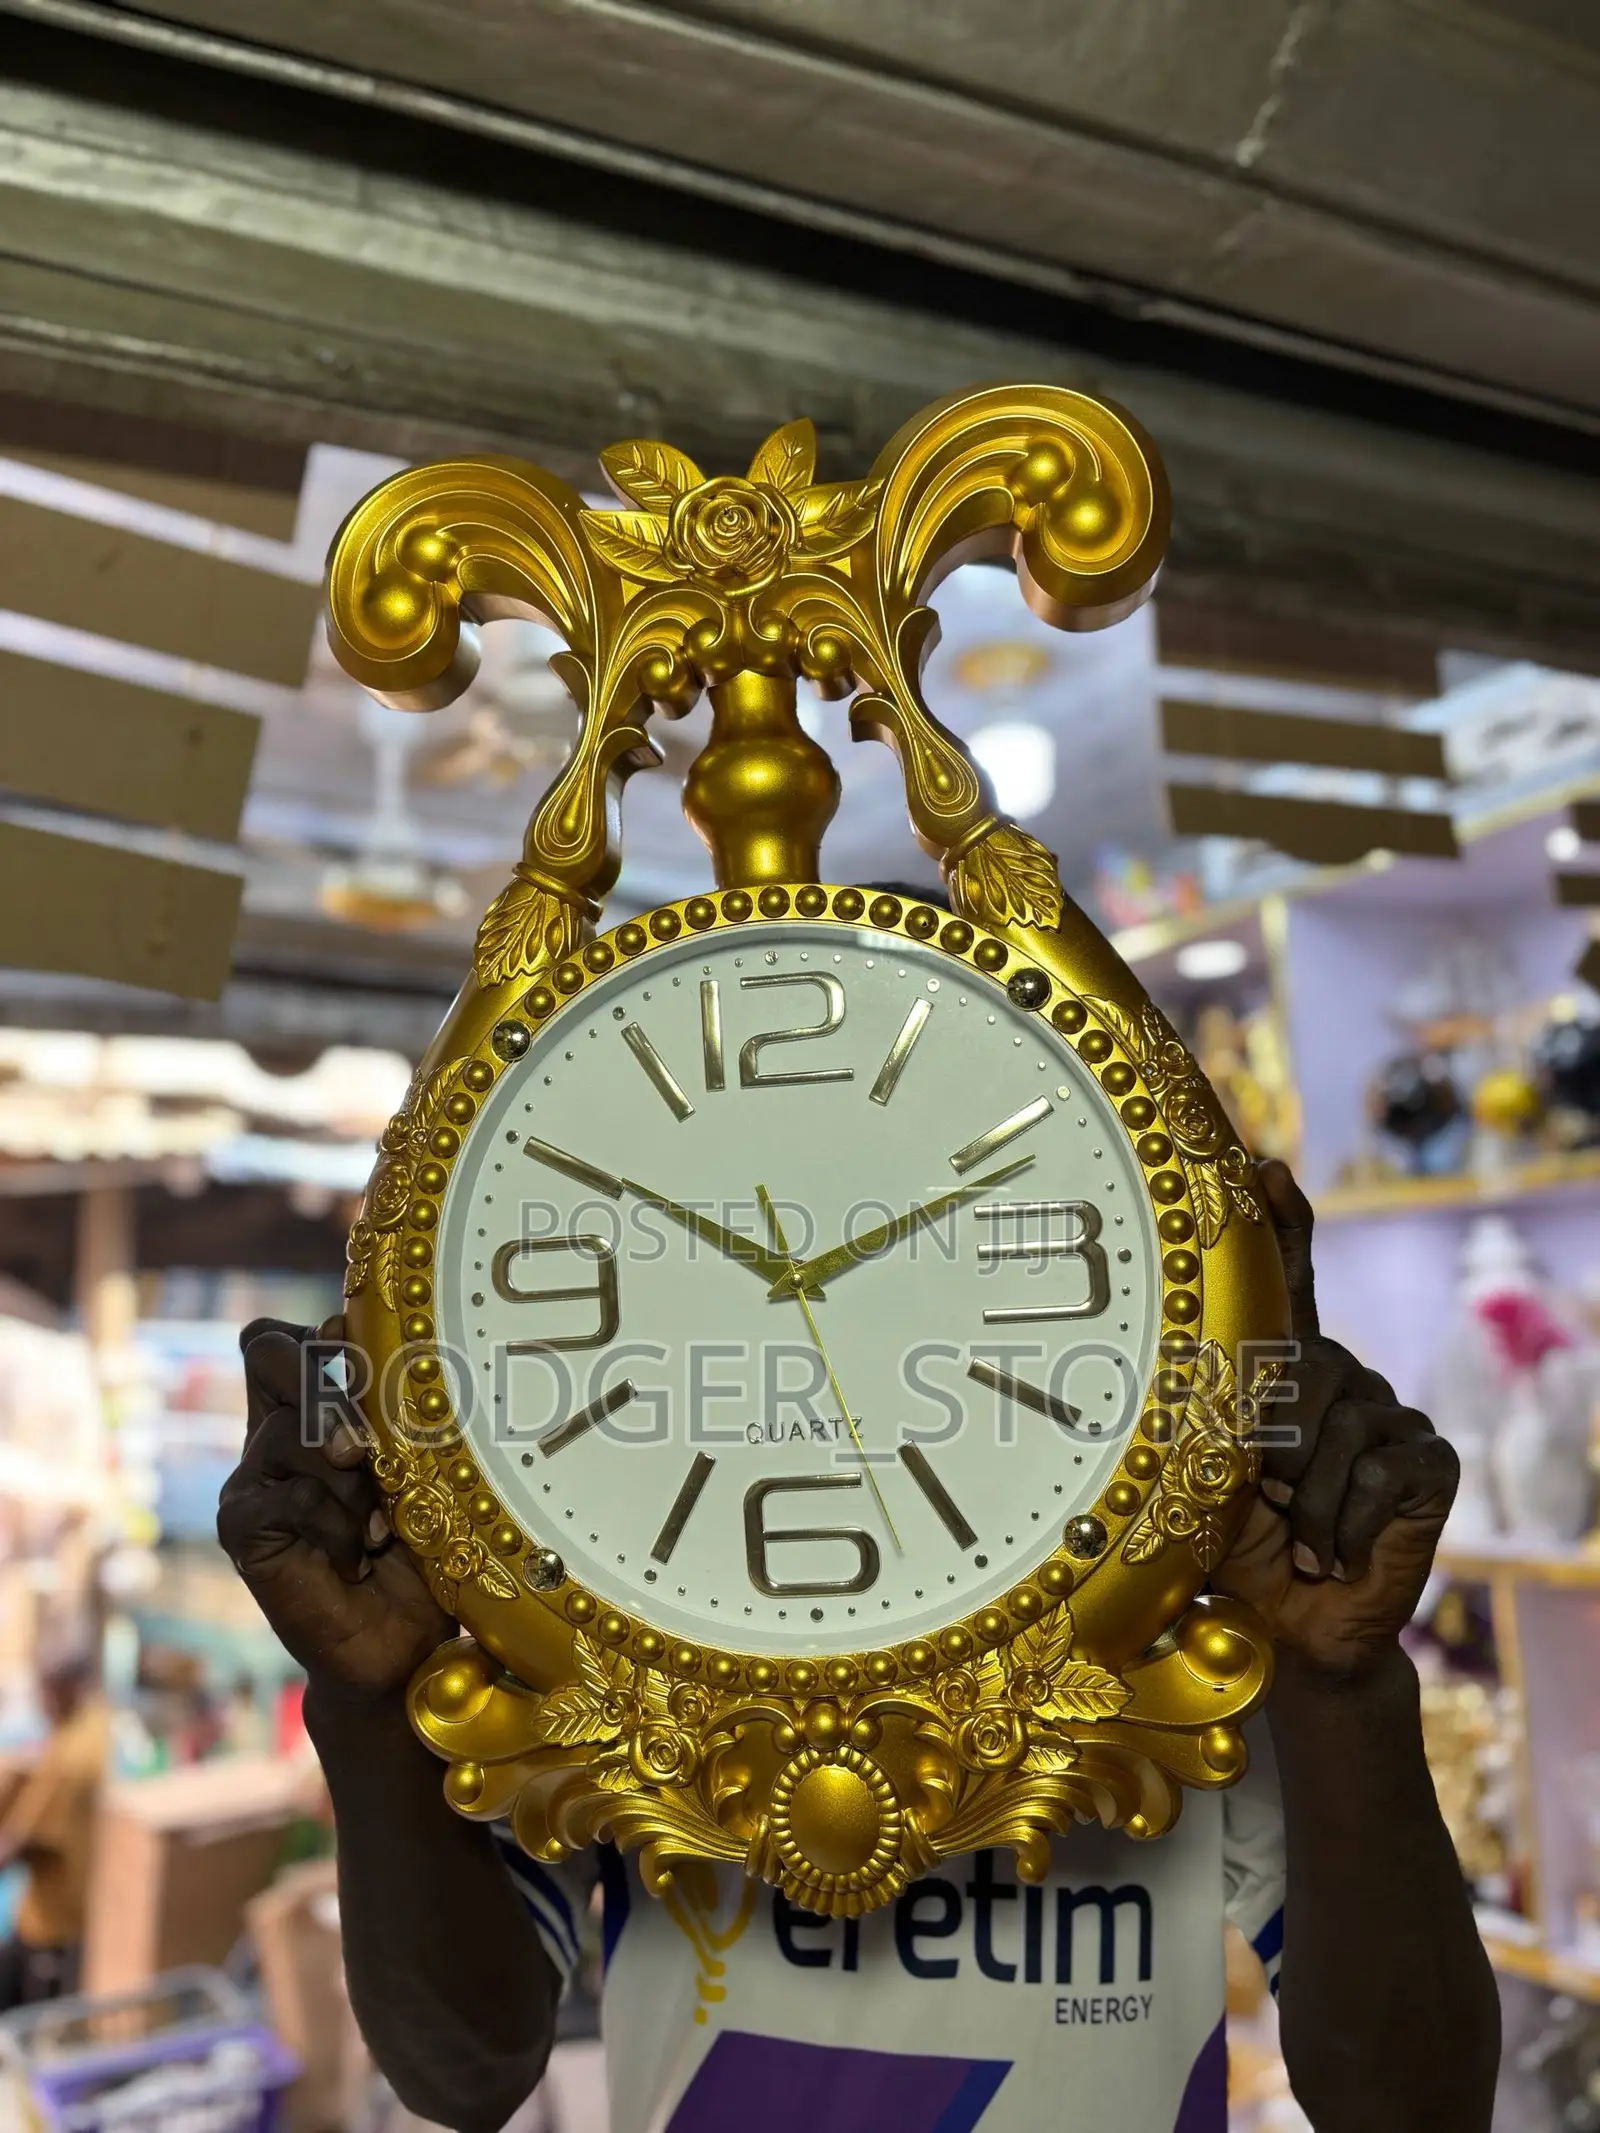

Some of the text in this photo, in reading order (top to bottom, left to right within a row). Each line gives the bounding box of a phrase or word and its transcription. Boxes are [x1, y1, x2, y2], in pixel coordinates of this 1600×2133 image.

[699, 969, 854, 1092] 12
[491, 1233, 622, 1356] 9
[974, 1200, 1111, 1325] 3
[746, 1415, 864, 1445] QUARTZ
[744, 1472, 881, 1597] 6
[1055, 1994, 1153, 2025] ENERGY
